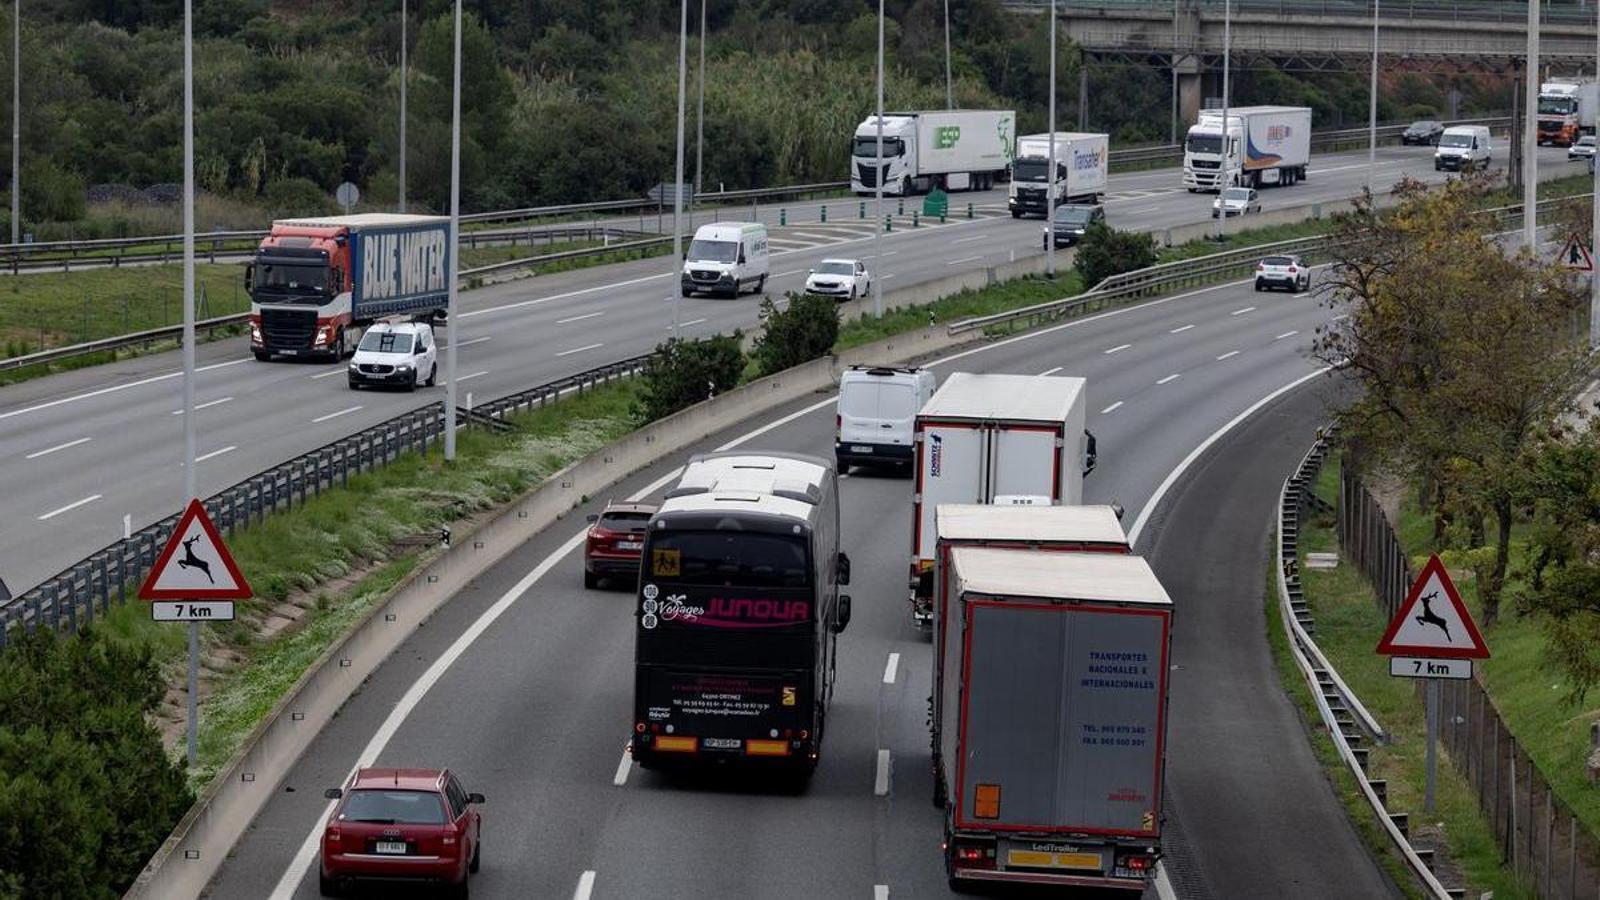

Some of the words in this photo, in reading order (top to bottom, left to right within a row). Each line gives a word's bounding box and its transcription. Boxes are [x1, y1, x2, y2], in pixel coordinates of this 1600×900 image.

[363, 234, 398, 299] BLUE
[400, 229, 445, 295] WATER
[175, 605, 184, 617] 7
[189, 605, 212, 617] km
[659, 600, 705, 622] Voyages
[1090, 652, 1147, 662] TRANSPORTES
[1088, 665, 1138, 674] NACIONALES
[1413, 661, 1422, 673] 7
[1427, 661, 1449, 674] km
[1081, 679, 1154, 689] INTERNACIONALES
